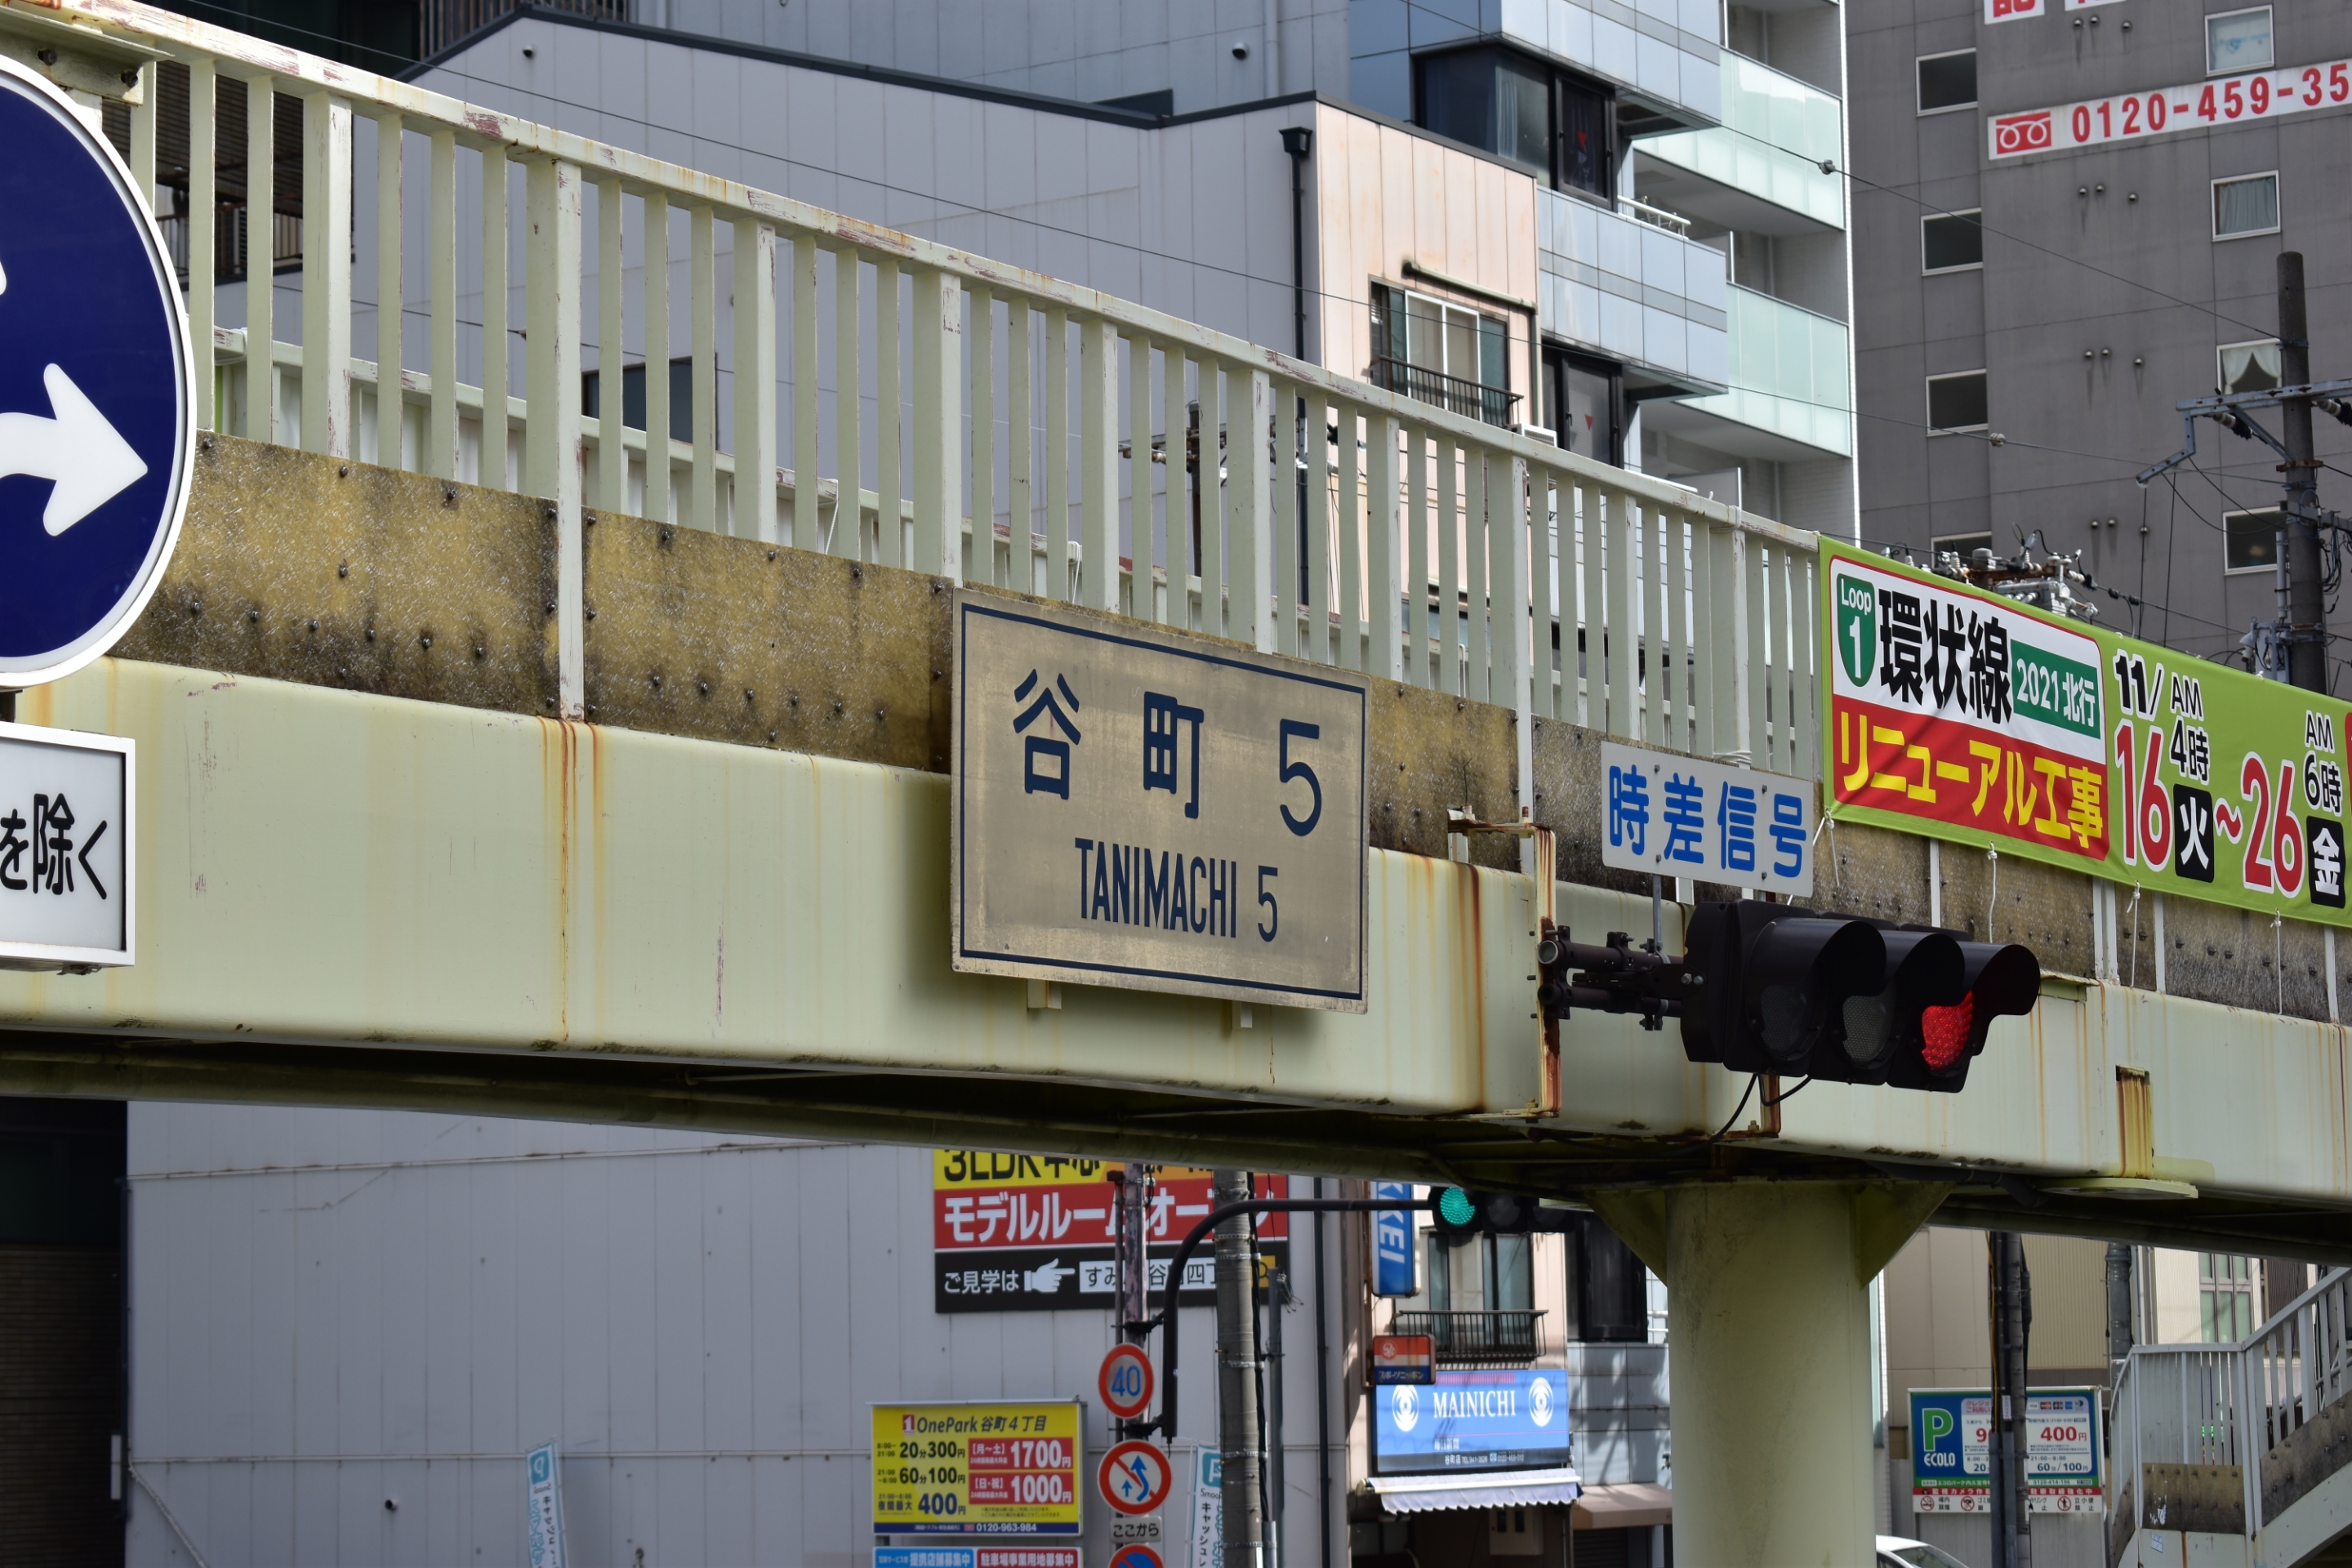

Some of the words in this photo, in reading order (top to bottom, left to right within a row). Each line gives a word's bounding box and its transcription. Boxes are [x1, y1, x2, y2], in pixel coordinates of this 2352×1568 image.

[1841, 577, 1872, 614] Loop
[1880, 590, 2011, 724] 環状線
[2171, 674, 2203, 717] AM
[2169, 717, 2210, 782] 4時
[2305, 712, 2335, 751] AM
[1841, 711, 2104, 849] リニューアル工事
[2304, 752, 2342, 815] 6時
[1609, 764, 1807, 878] 時差信号
[2180, 796, 2210, 871] 火
[2312, 826, 2341, 897] 金
[1074, 836, 1237, 939] TANIMACHI
[1257, 864, 1279, 942] 5
[944, 1269, 1019, 1294] ご見学は
[1111, 1365, 1142, 1397] 40
[916, 1415, 978, 1433] OnePark
[1433, 1390, 1517, 1419] MAINICHI
[1924, 1452, 1956, 1468] ECOLO
[976, 1523, 1037, 1532] 0120-963-984
[1113, 1522, 1159, 1539] ここから
